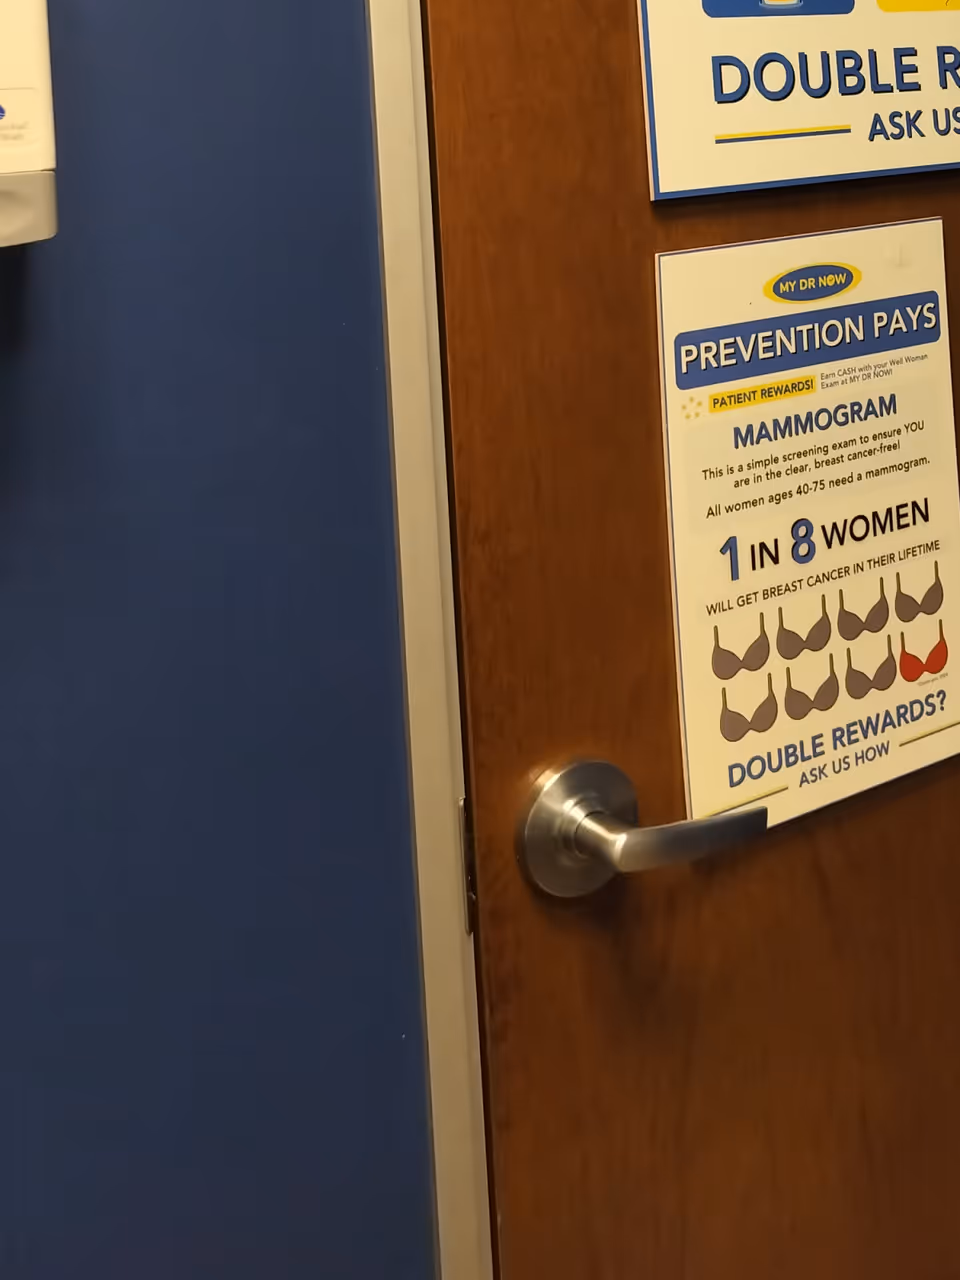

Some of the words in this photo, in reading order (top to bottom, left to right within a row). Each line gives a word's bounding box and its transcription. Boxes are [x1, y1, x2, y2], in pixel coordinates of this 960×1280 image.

[711, 46, 921, 104] DOUBLE
[868, 109, 925, 142] ASK
[779, 280, 796, 293] MY
[799, 277, 815, 290] DR
[818, 272, 846, 287] NOW
[680, 315, 864, 373] PREVENTION
[873, 302, 936, 337] PAYS
[712, 390, 757, 408] PATIENT
[760, 378, 813, 399] REWARDS!
[820, 372, 836, 380] Earn
[836, 366, 856, 377] CASH
[857, 363, 872, 372] with
[873, 361, 888, 371] your
[889, 357, 903, 366] Well
[904, 354, 928, 363] Woman
[820, 380, 839, 389] Exam
[849, 374, 860, 384] MY
[861, 372, 871, 381] DR
[733, 393, 897, 449] MAMMOGRAM
[701, 467, 723, 480] This
[726, 464, 734, 475] is
[737, 464, 743, 472] a
[746, 453, 779, 470] simple
[782, 444, 829, 462] screening
[831, 438, 857, 450] exam
[859, 435, 869, 444] to
[871, 427, 901, 441] ensure
[903, 419, 924, 433] YOU
[733, 477, 750, 488] are
[753, 473, 762, 483] in
[765, 468, 782, 480] the
[784, 463, 811, 476] clear,
[814, 453, 844, 469] breast
[847, 439, 900, 461] cancer-free!
[706, 503, 721, 519] All
[724, 497, 764, 513] women
[768, 489, 793, 505] ages
[796, 478, 825, 495] 40-75
[828, 471, 853, 488] need
[856, 472, 862, 481] a
[865, 456, 930, 479] mammogram.
[719, 535, 739, 581] 1
[750, 538, 779, 571] IN
[790, 517, 816, 564] 8
[820, 497, 929, 549] WOMEN
[705, 599, 734, 616] WILL
[736, 591, 759, 607] GET
[762, 578, 804, 600] BREAST
[806, 565, 850, 587] CANCER
[853, 561, 864, 574] IN
[866, 552, 895, 570] THEIR
[898, 539, 940, 561] LIFETIME
[727, 733, 825, 788] DOUBLE
[831, 689, 946, 750] REWARDS?
[798, 763, 828, 788] ASK
[831, 755, 850, 774] US
[854, 740, 889, 766] HOW
